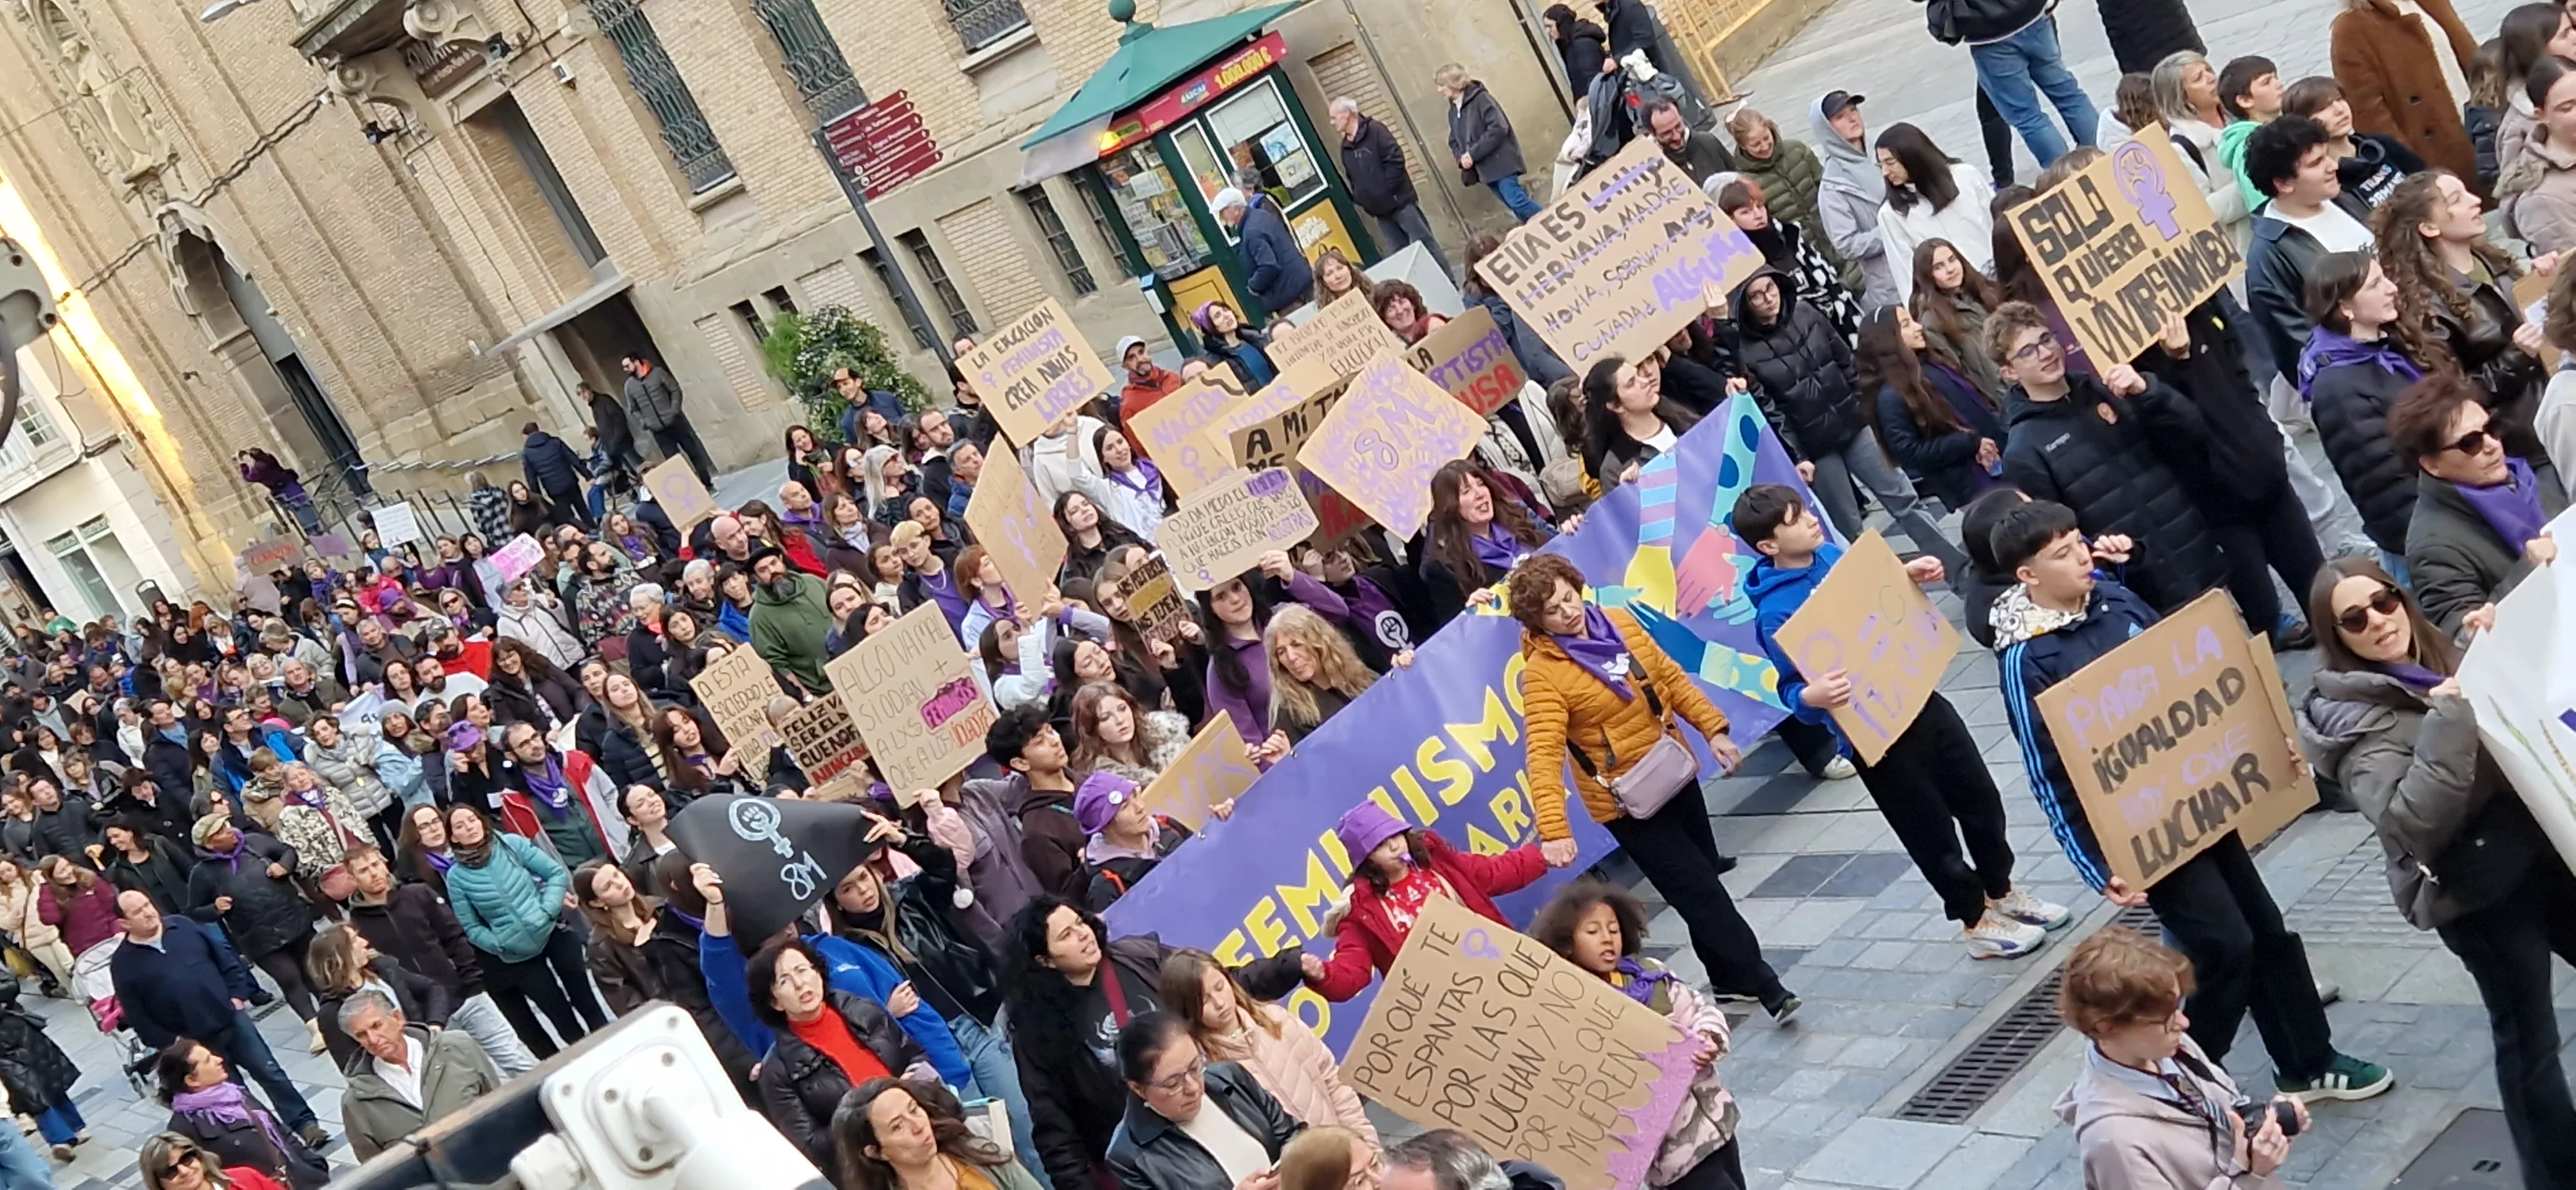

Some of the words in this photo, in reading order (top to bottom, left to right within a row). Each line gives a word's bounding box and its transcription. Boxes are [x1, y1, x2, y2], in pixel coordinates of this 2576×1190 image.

[2360, 164, 2392, 191] TRANS
[1539, 201, 1587, 244] ES
[2017, 175, 2115, 267] SOLO
[2053, 223, 2146, 304] QUIERO
[971, 350, 991, 370] LA
[1005, 376, 1041, 411] CREA
[1246, 428, 1273, 460] A
[1354, 393, 1437, 471] 8M
[697, 680, 712, 699] A
[711, 656, 751, 690] ESTA
[761, 675, 779, 700] LE
[838, 644, 896, 702] ALGO
[2065, 664, 2159, 750] PARA
[2172, 625, 2224, 677] LA
[782, 704, 828, 737] FELIZ
[2091, 666, 2246, 794] IGUALDAD
[799, 741, 833, 768] QUE
[876, 738, 892, 761] A
[917, 747, 932, 771] A
[2181, 723, 2251, 786] QUE
[2130, 753, 2271, 880] LUCHAR
[781, 851, 828, 900] 8M
[1419, 922, 1459, 957] TE
[1539, 970, 1585, 1023] NO
[1394, 972, 1483, 1108] ESPANTAS
[1432, 1068, 1486, 1128] POR
[1464, 1000, 1517, 1062] LAS
[1497, 939, 1552, 998] QUE
[1526, 1015, 1558, 1051] Y
[1472, 1039, 1547, 1151] LUCHAN
[1513, 1114, 1558, 1163] POR
[1542, 1060, 1587, 1110] LAS
[1575, 996, 1625, 1054] QUE
[1558, 1039, 1645, 1166] MUEREN
